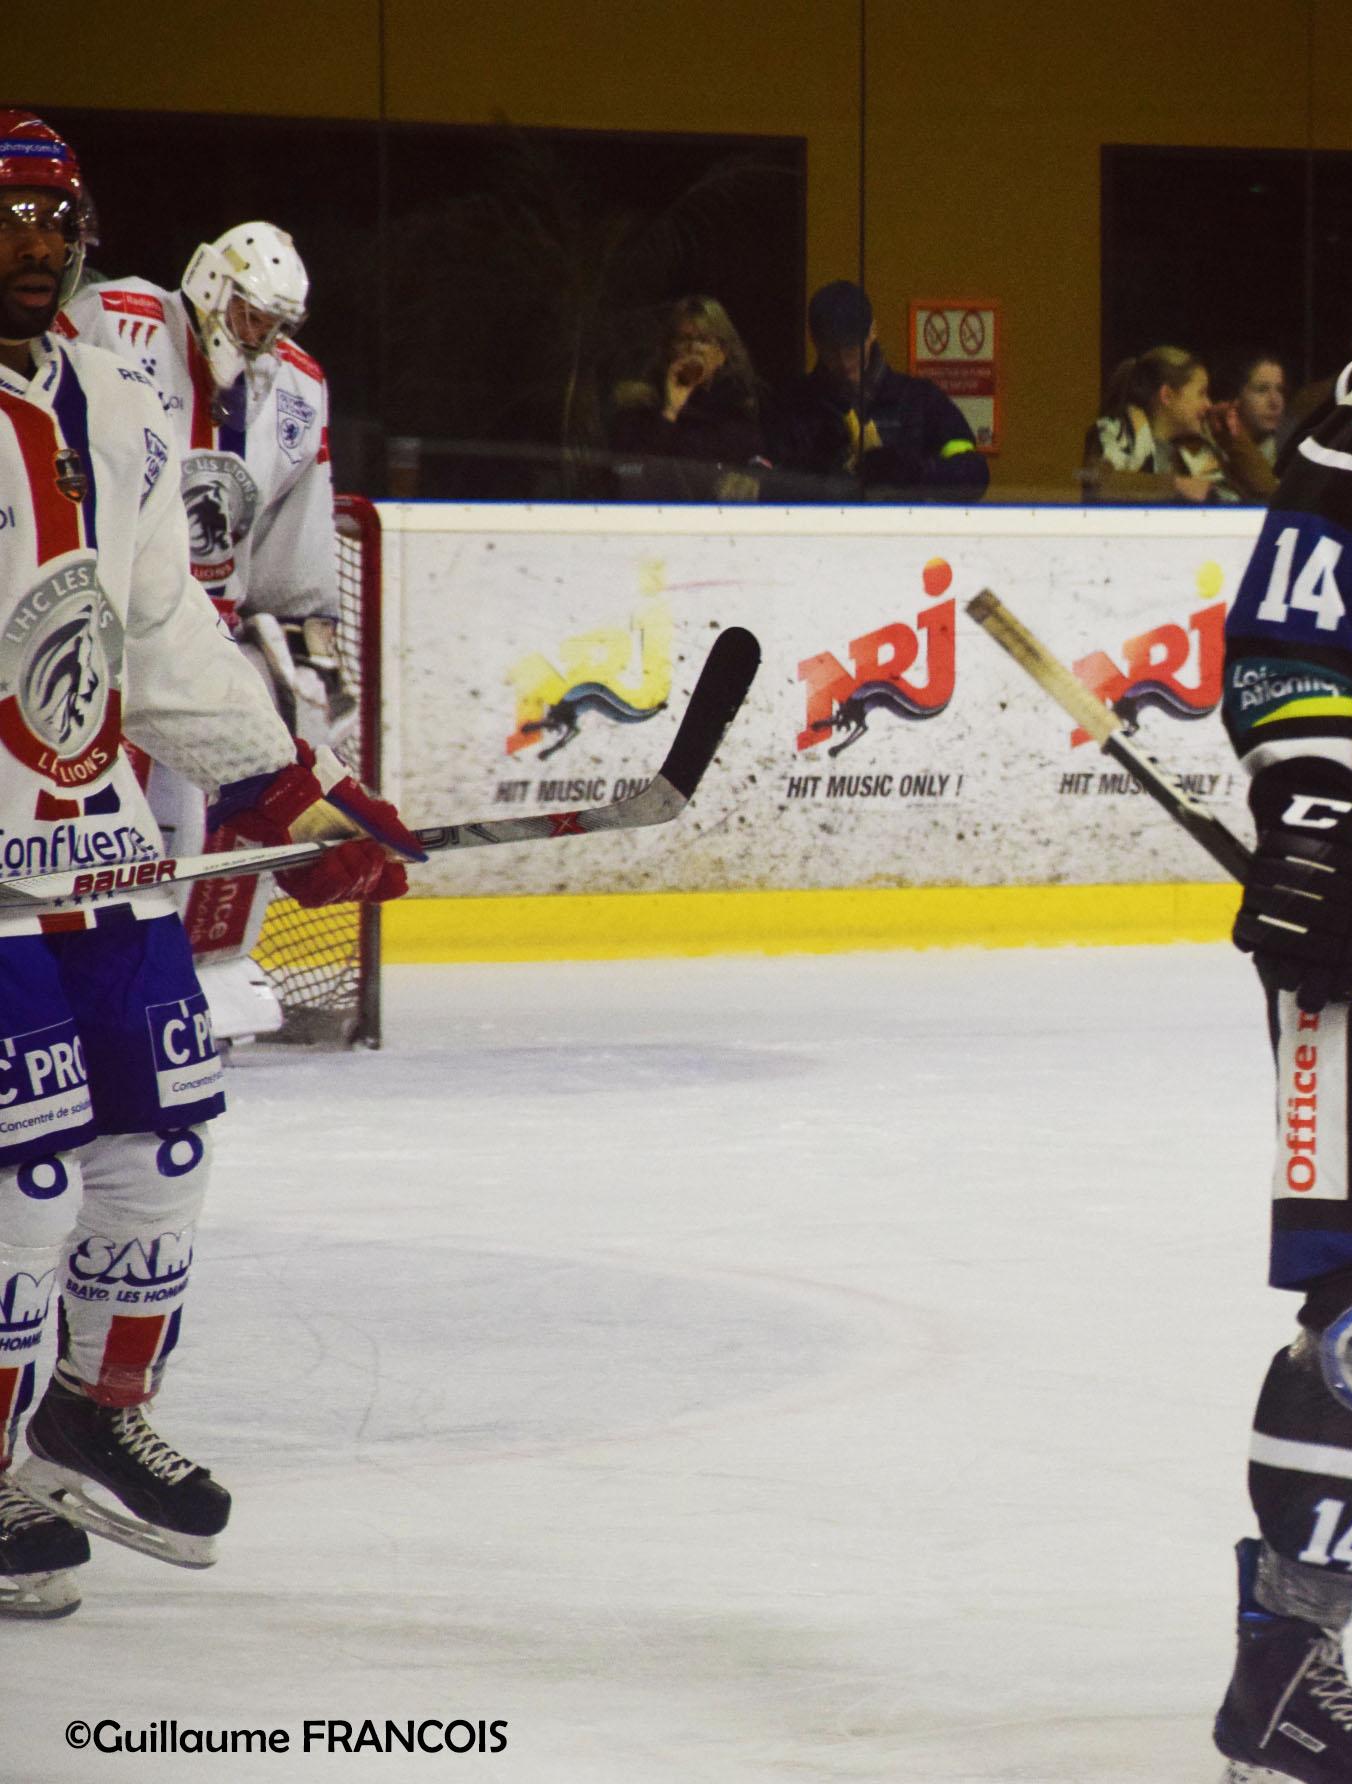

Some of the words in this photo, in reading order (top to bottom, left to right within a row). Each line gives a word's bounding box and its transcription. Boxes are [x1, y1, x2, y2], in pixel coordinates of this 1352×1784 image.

[1257, 527, 1346, 631] 14
[6, 591, 50, 644] LHC
[52, 566, 88, 596] LES
[60, 747, 108, 783] LIONS
[493, 779, 531, 802] HIT
[537, 777, 607, 802] MUSIC
[787, 775, 819, 799] HIT
[826, 774, 893, 798] MUSIC
[899, 774, 951, 798] ONLY
[1059, 773, 1094, 795] HIT
[1286, 1044, 1317, 1193] Office
[116, 1290, 141, 1304] LES
